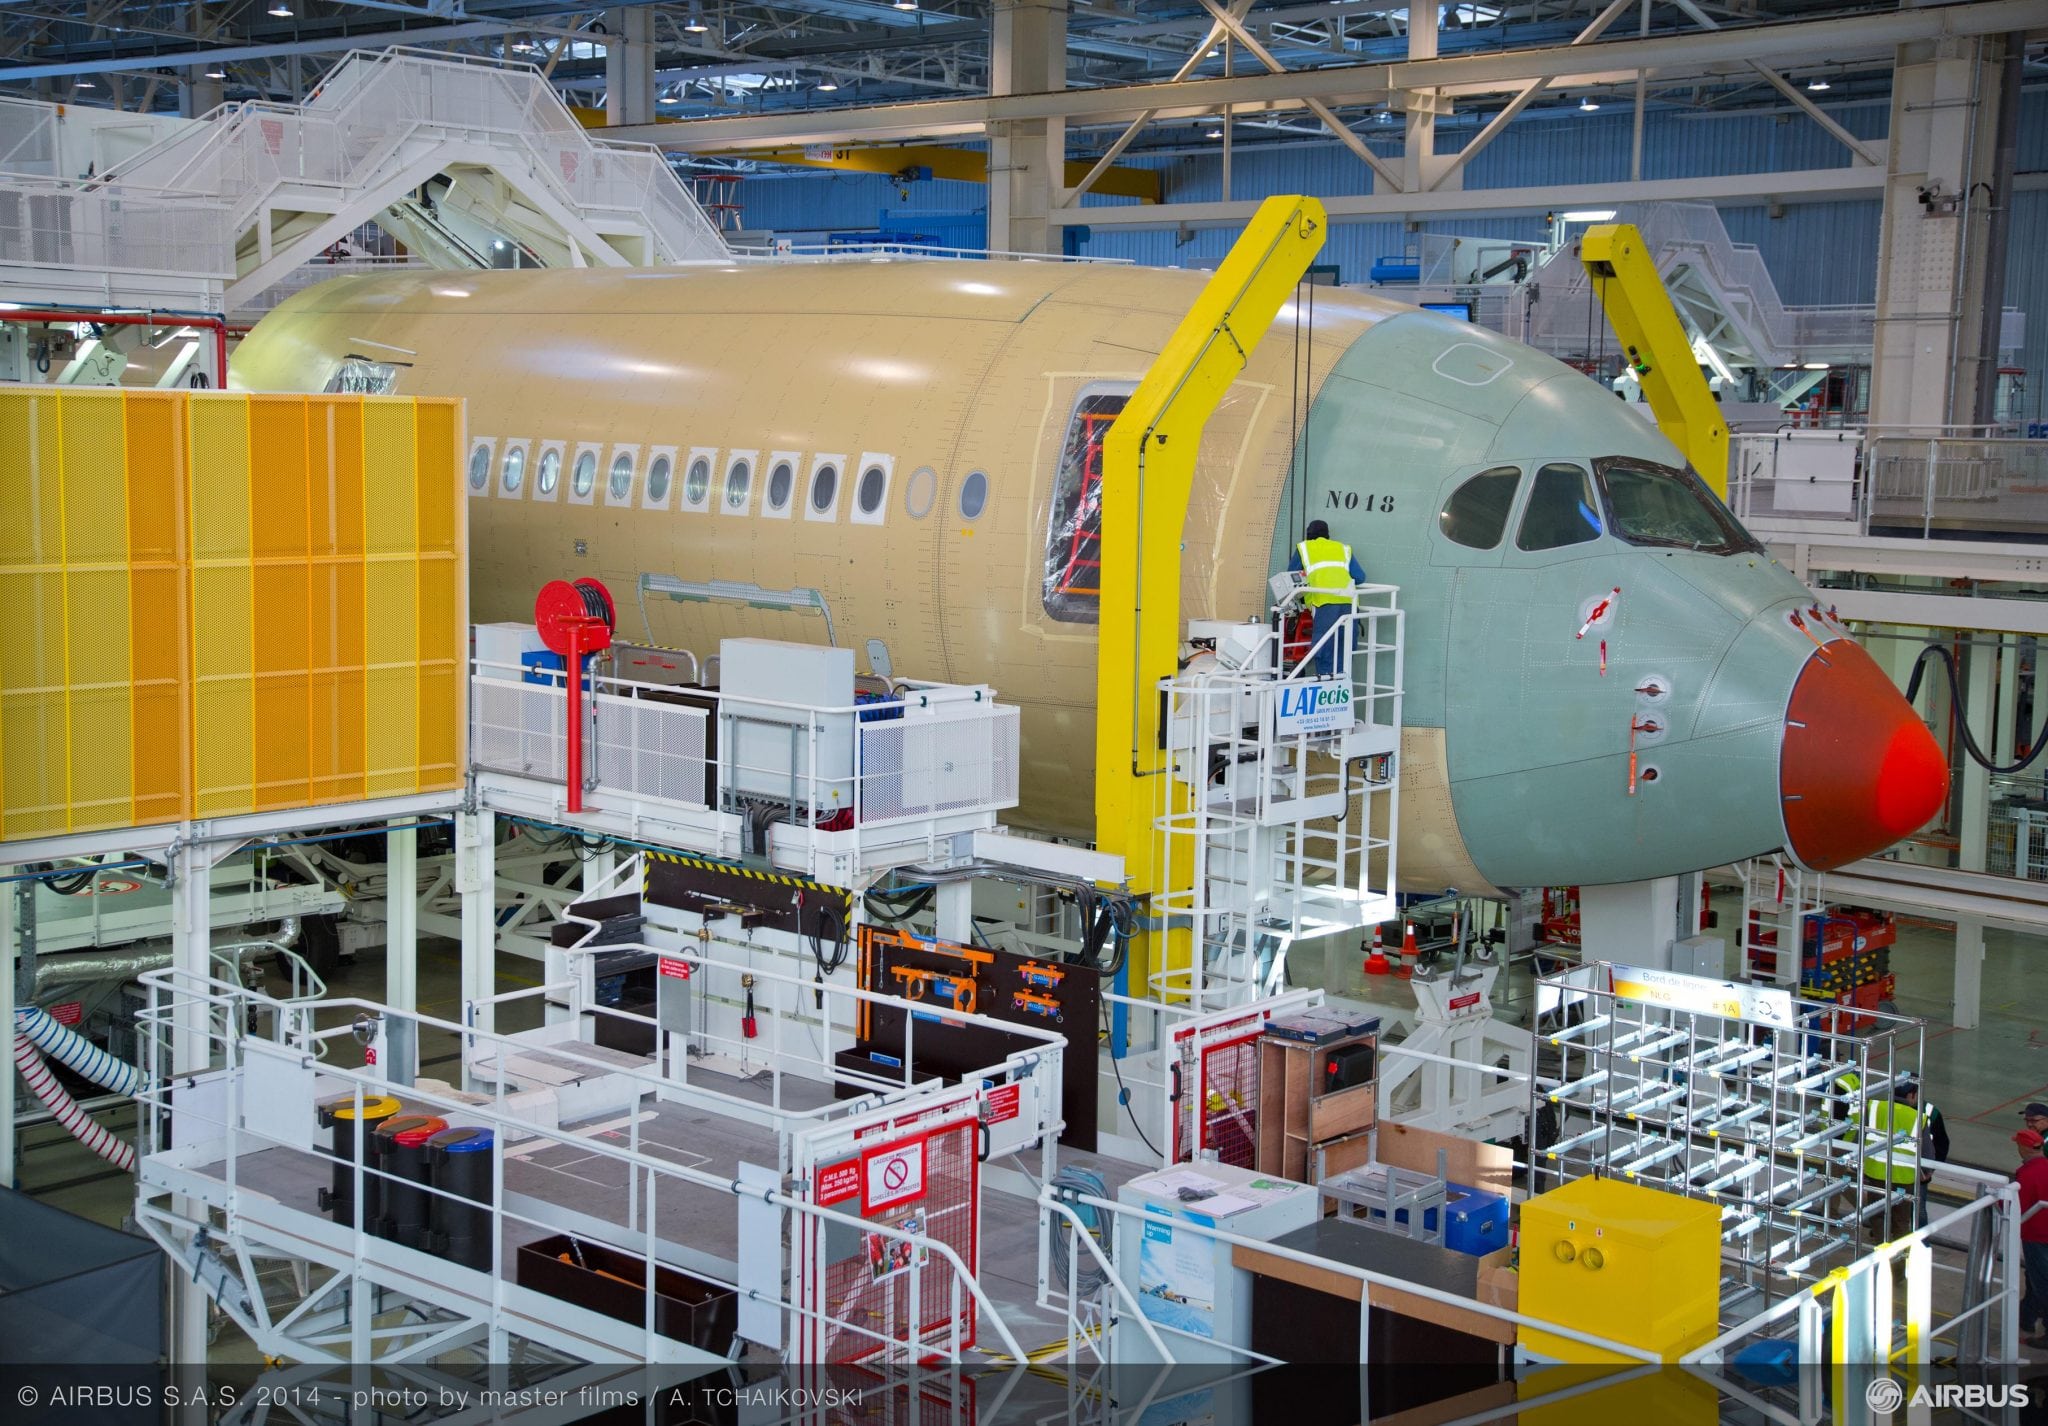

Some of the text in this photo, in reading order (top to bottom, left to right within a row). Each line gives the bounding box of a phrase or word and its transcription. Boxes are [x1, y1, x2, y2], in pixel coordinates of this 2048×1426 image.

[1280, 684, 1350, 718] LATecis
[1642, 972, 1666, 983] Bord
[1668, 976, 1681, 985] de
[1722, 1003, 1736, 1014] 1A
